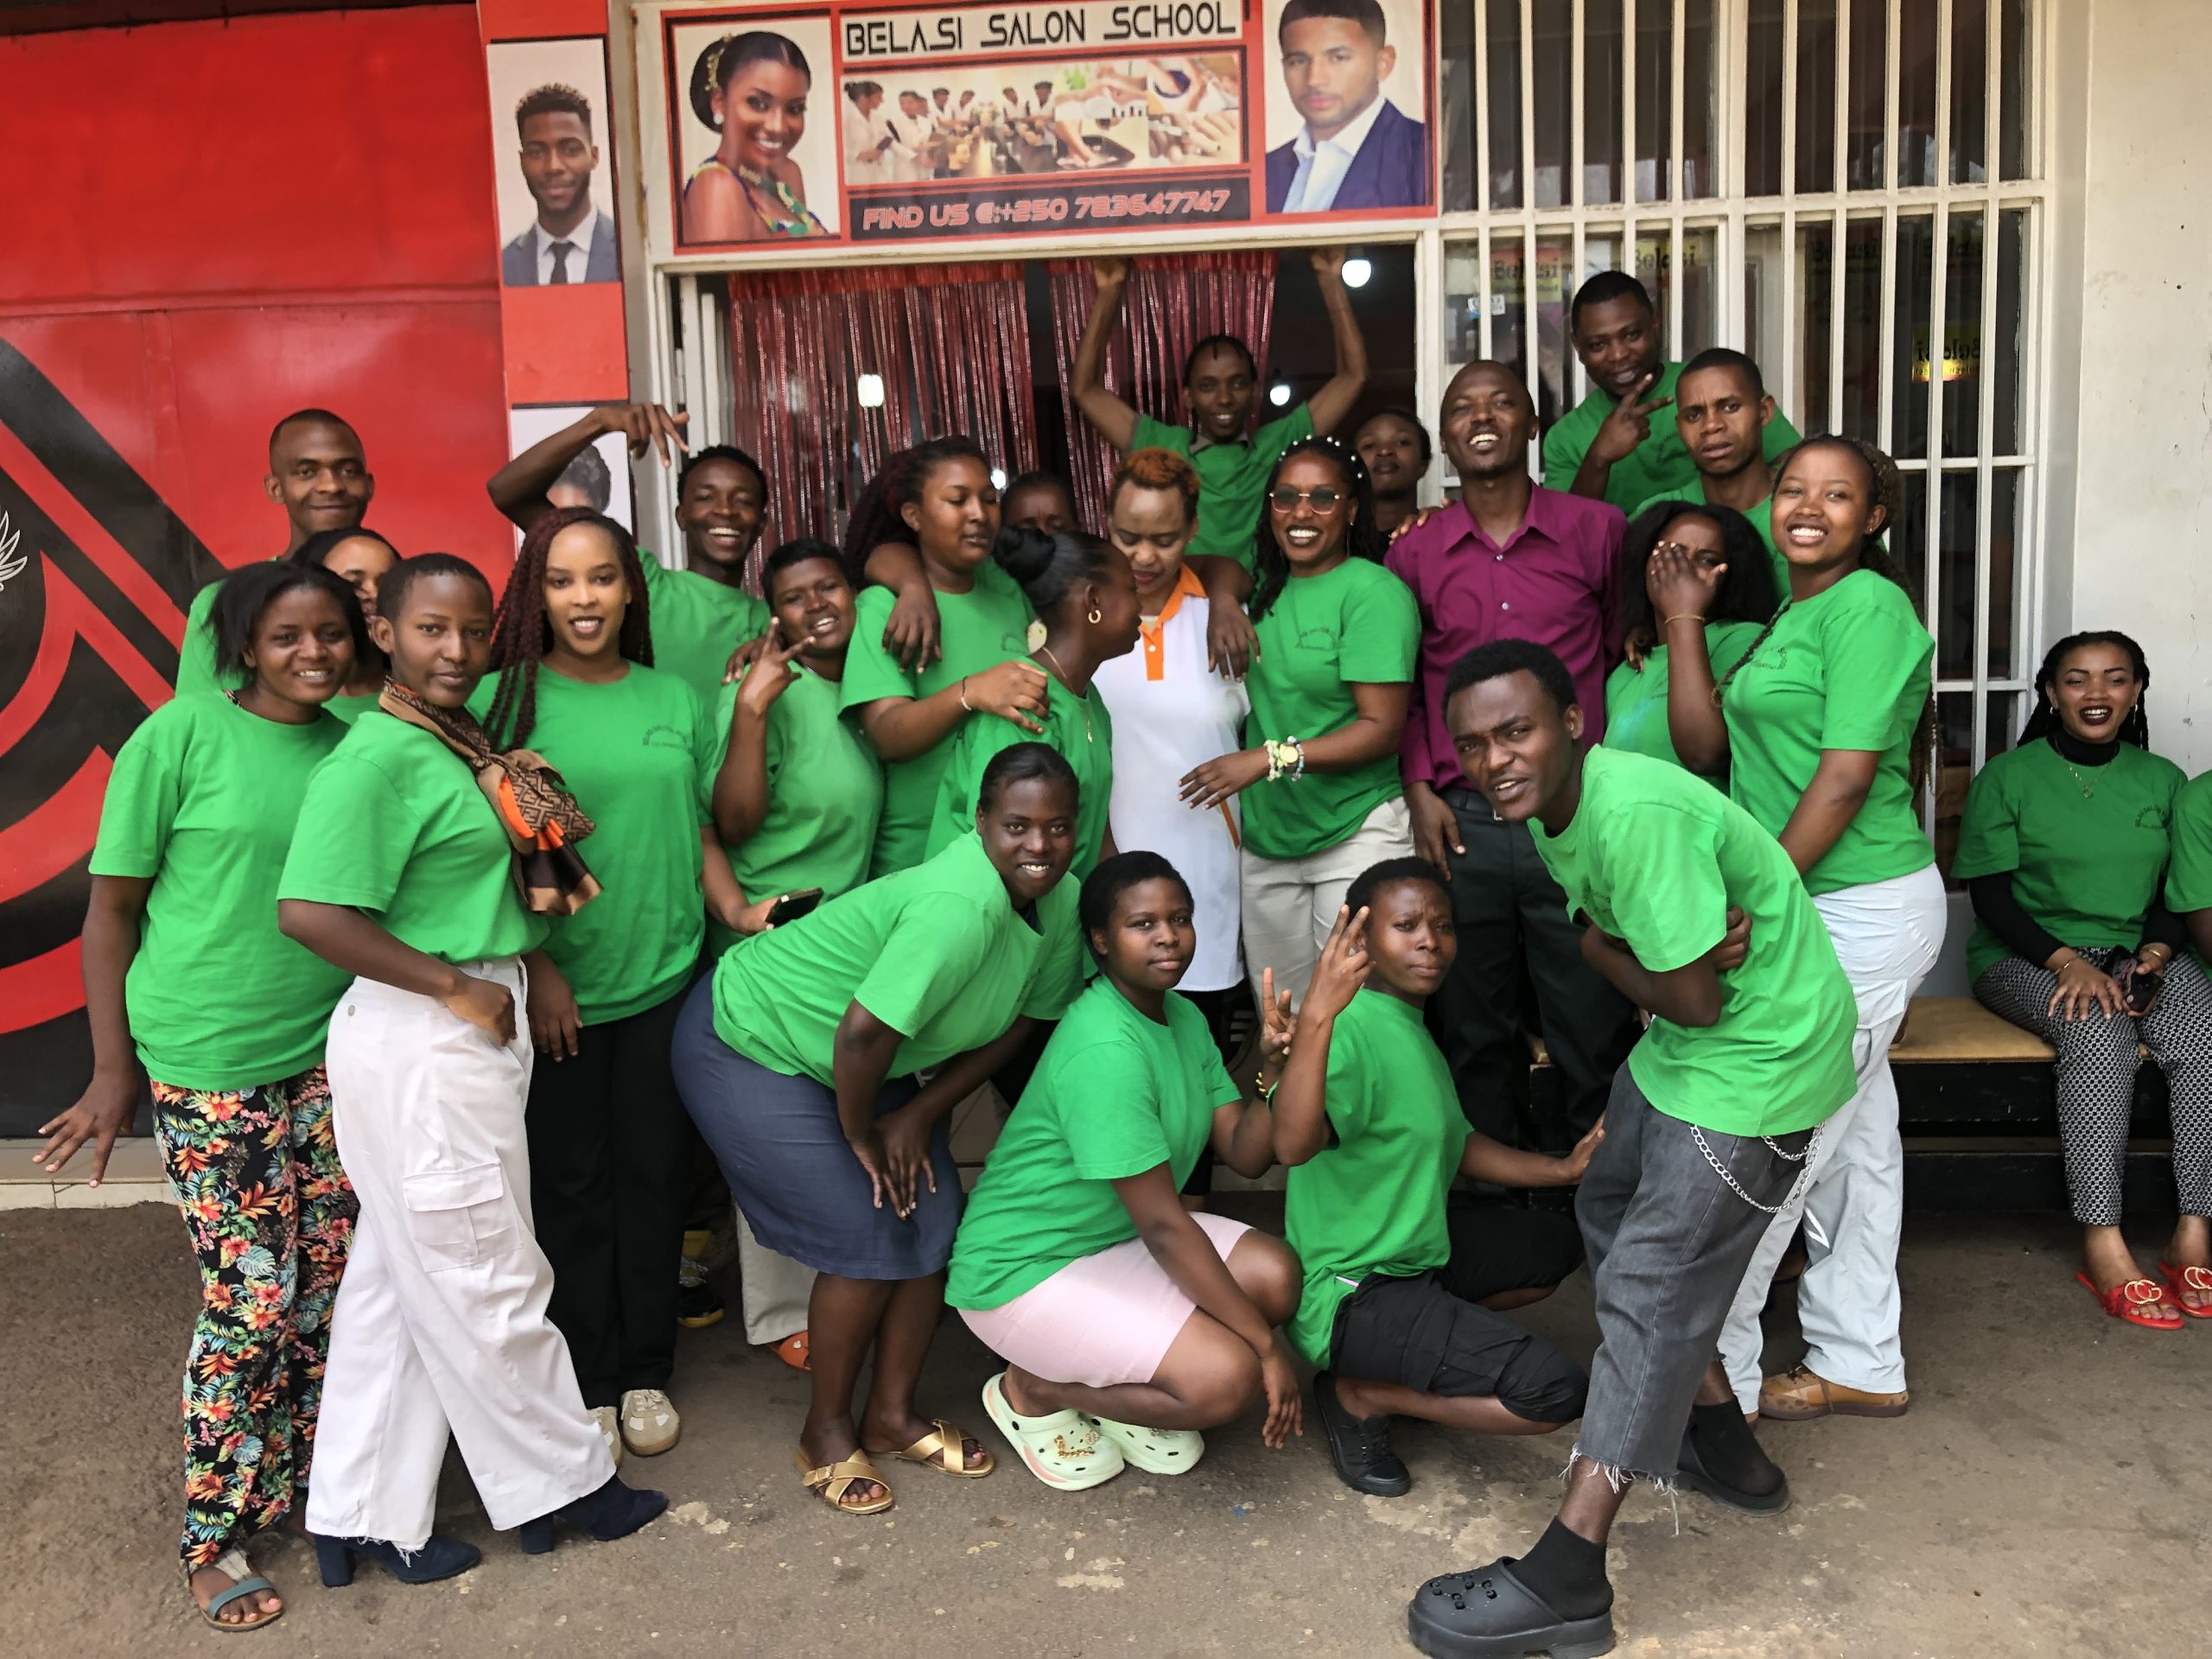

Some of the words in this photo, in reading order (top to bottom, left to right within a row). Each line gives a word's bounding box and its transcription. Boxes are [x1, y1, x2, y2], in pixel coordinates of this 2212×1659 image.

[846, 16, 963, 56] BELASI
[981, 9, 1085, 48] SALON
[1103, 2, 1236, 40] SCHOOL
[862, 206, 925, 231] FIND
[929, 203, 969, 227] US
[1074, 189, 1231, 219] 783647747
